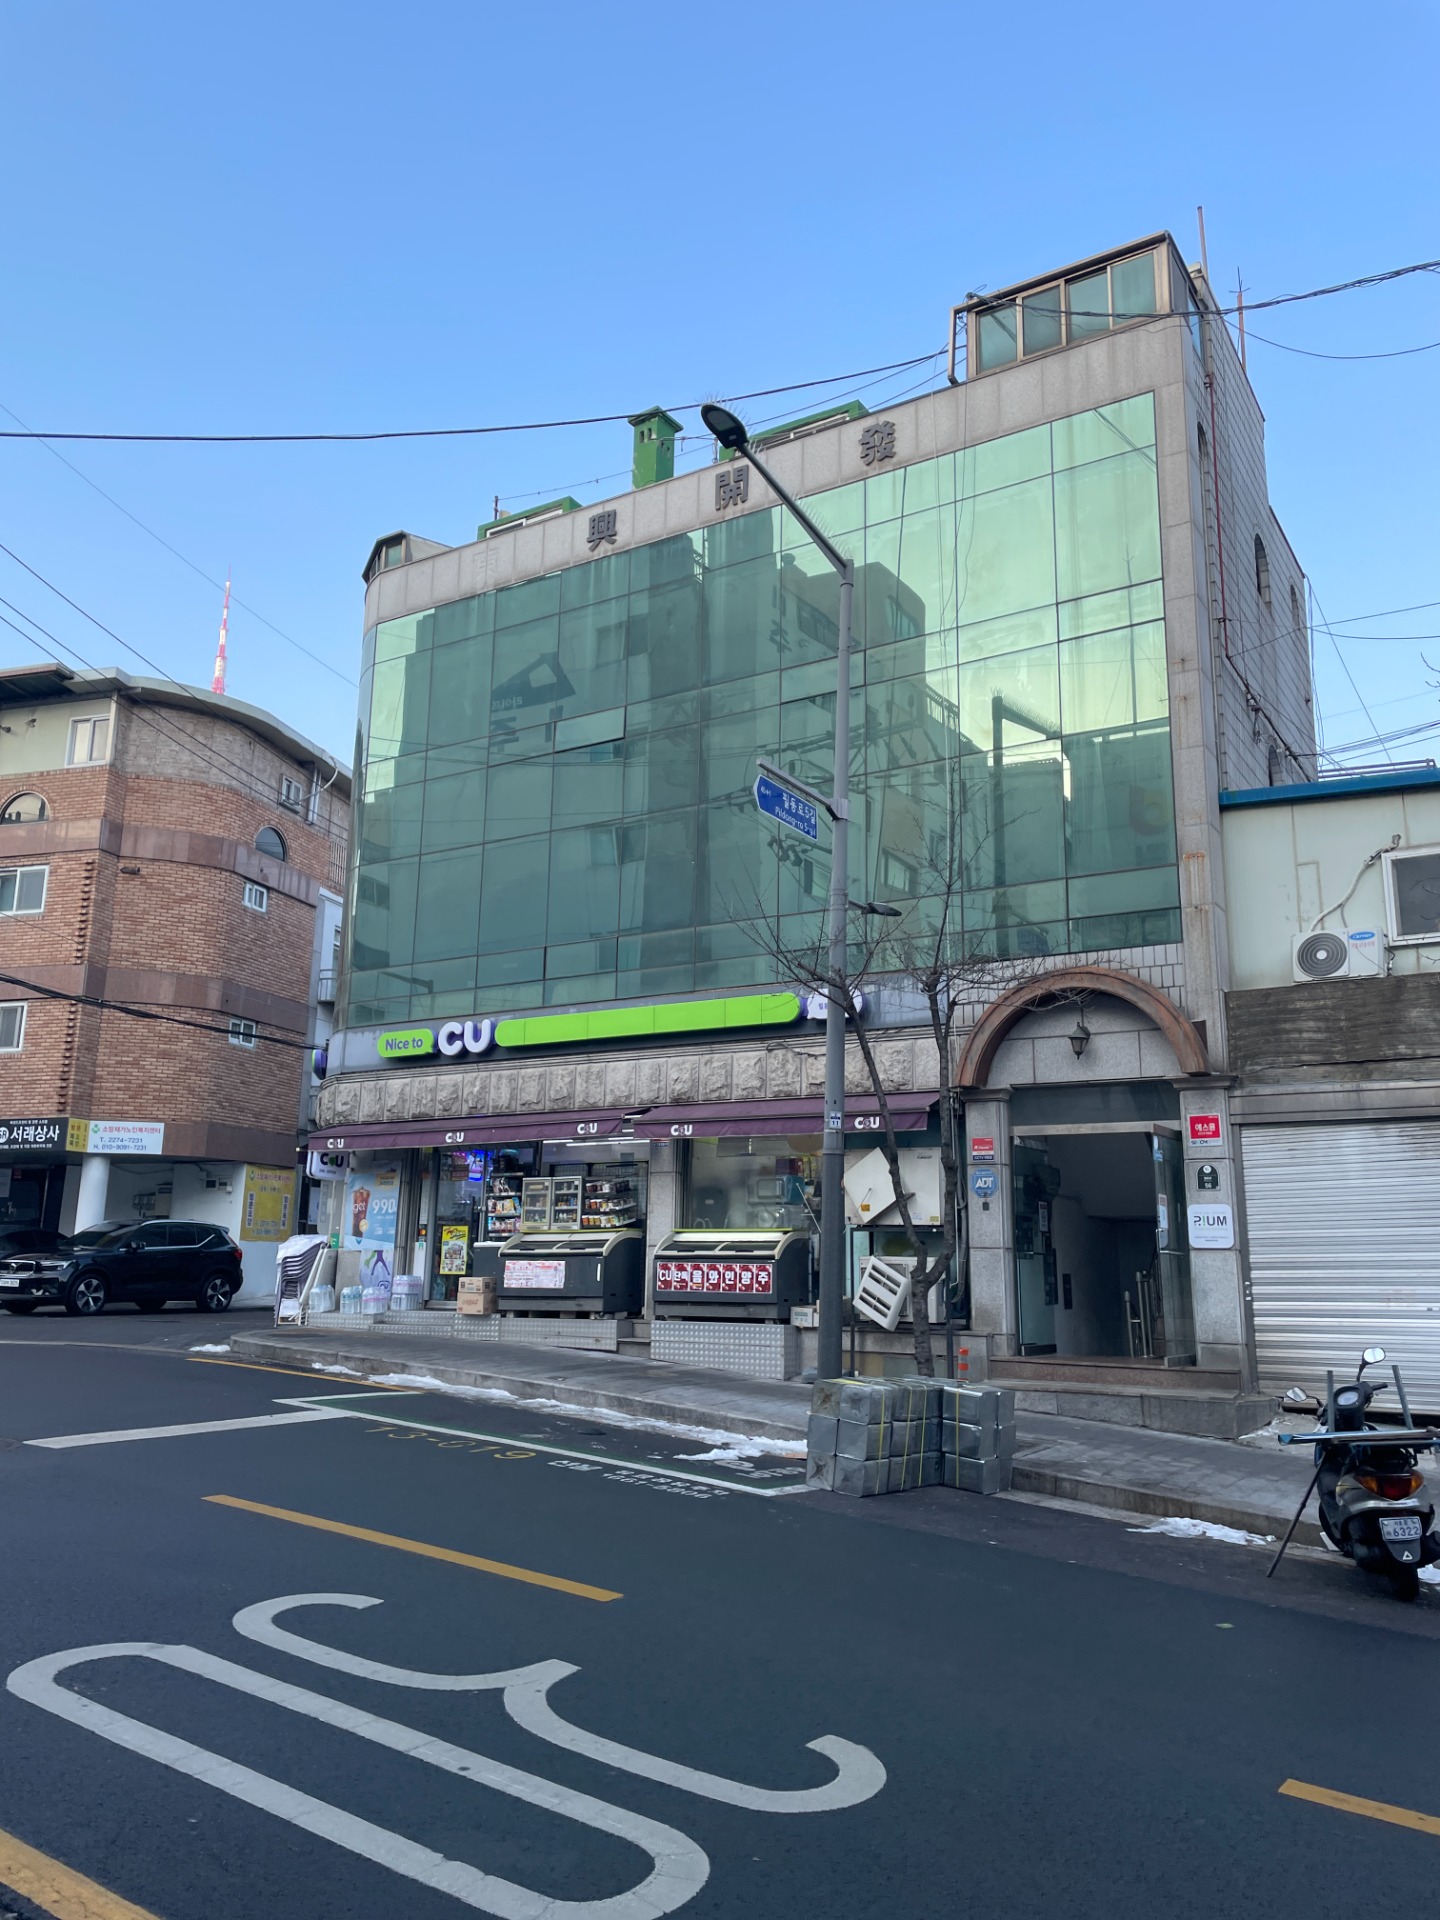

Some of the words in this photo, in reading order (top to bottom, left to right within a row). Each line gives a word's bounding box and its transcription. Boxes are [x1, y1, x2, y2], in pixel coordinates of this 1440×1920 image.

[782, 792, 816, 825] 필동로5길
[775, 806, 804, 828] Pildong-ro
[804, 824, 816, 836] 5-gil
[385, 1038, 409, 1051] Nice
[412, 1037, 423, 1049] to
[438, 1019, 491, 1056] CU
[577, 1123, 598, 1134] CU
[854, 1116, 880, 1129] CU
[1195, 1122, 1216, 1132] 에스원
[10, 1124, 60, 1142] 서래상사
[671, 1124, 693, 1136] CU
[445, 1132, 465, 1143] CU
[320, 1152, 344, 1168] CU
[975, 1177, 994, 1188] ADT
[659, 1269, 672, 1281] CU
[1393, 1525, 1420, 1537] 6322
